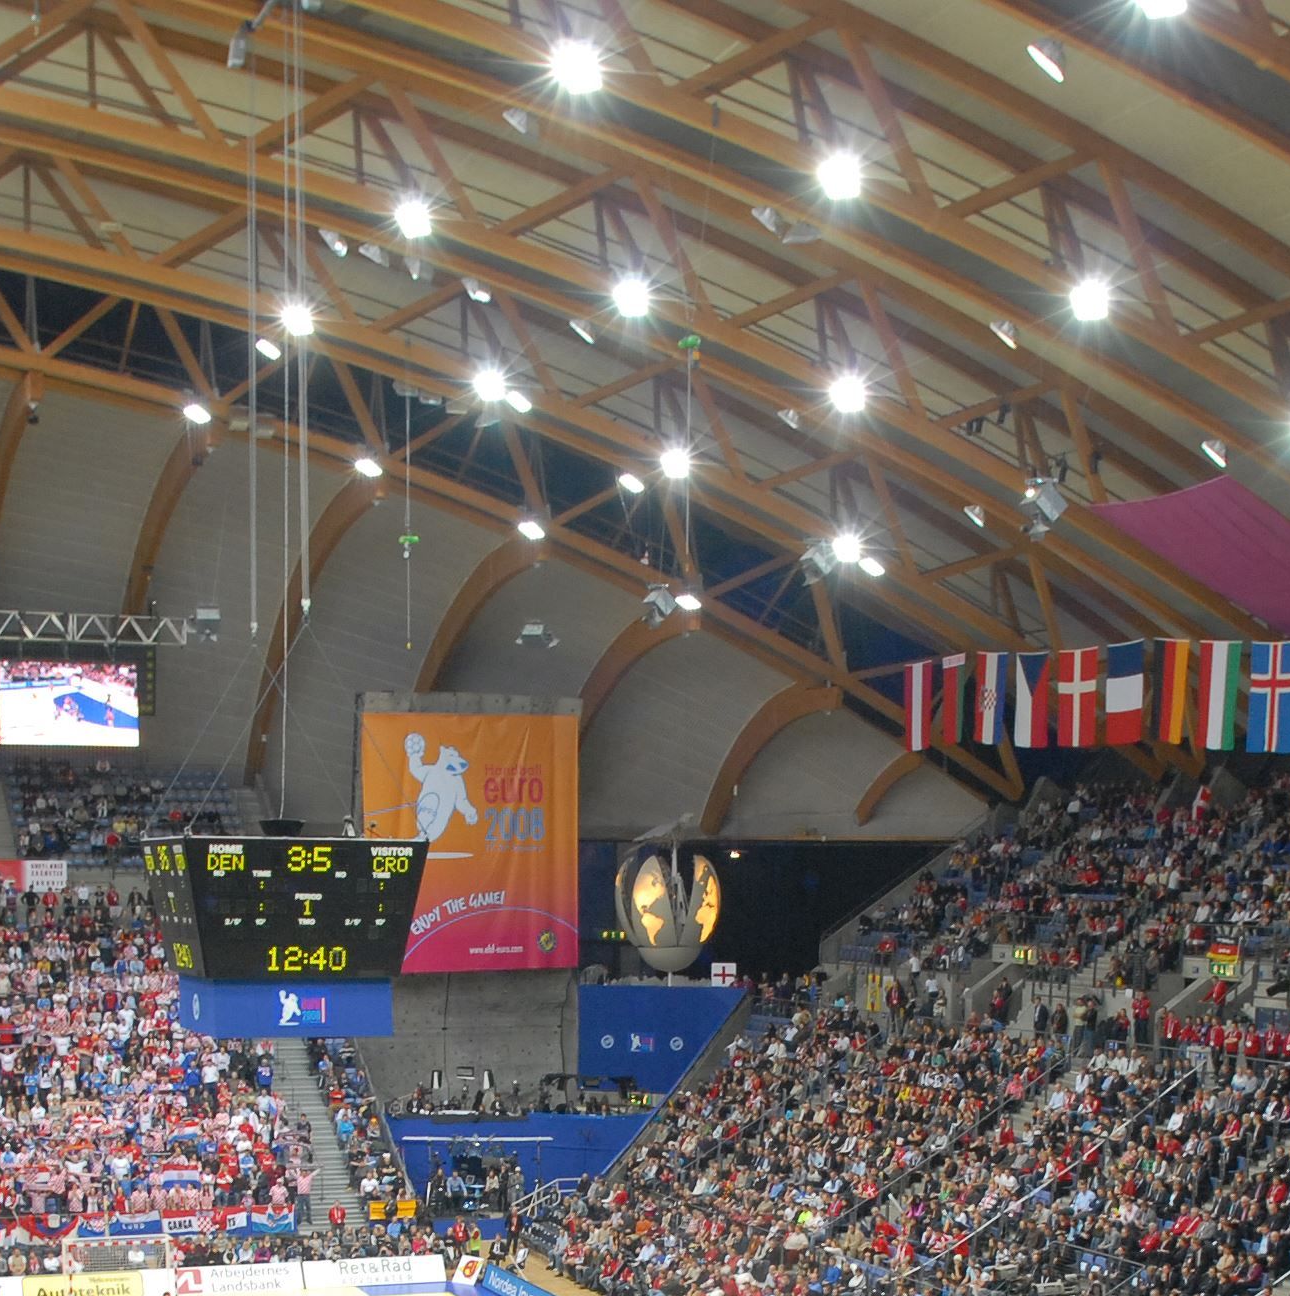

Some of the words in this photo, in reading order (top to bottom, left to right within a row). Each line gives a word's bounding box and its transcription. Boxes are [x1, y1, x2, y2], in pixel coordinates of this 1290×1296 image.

[484, 776, 544, 804] euro
[485, 807, 545, 841] 2008
[209, 844, 244, 854] HOME
[371, 846, 413, 857] VISITOR
[207, 854, 245, 871] DEN
[287, 846, 333, 872] 3:5
[372, 856, 409, 873] CRO
[303, 899, 313, 916] 1
[410, 908, 441, 936] ENJOY
[443, 898, 467, 914] THE
[469, 891, 505, 908] GAME!
[268, 946, 347, 971] 12:40
[210, 1265, 290, 1280] Arbejdernes
[211, 1279, 283, 1293] Landsbank
